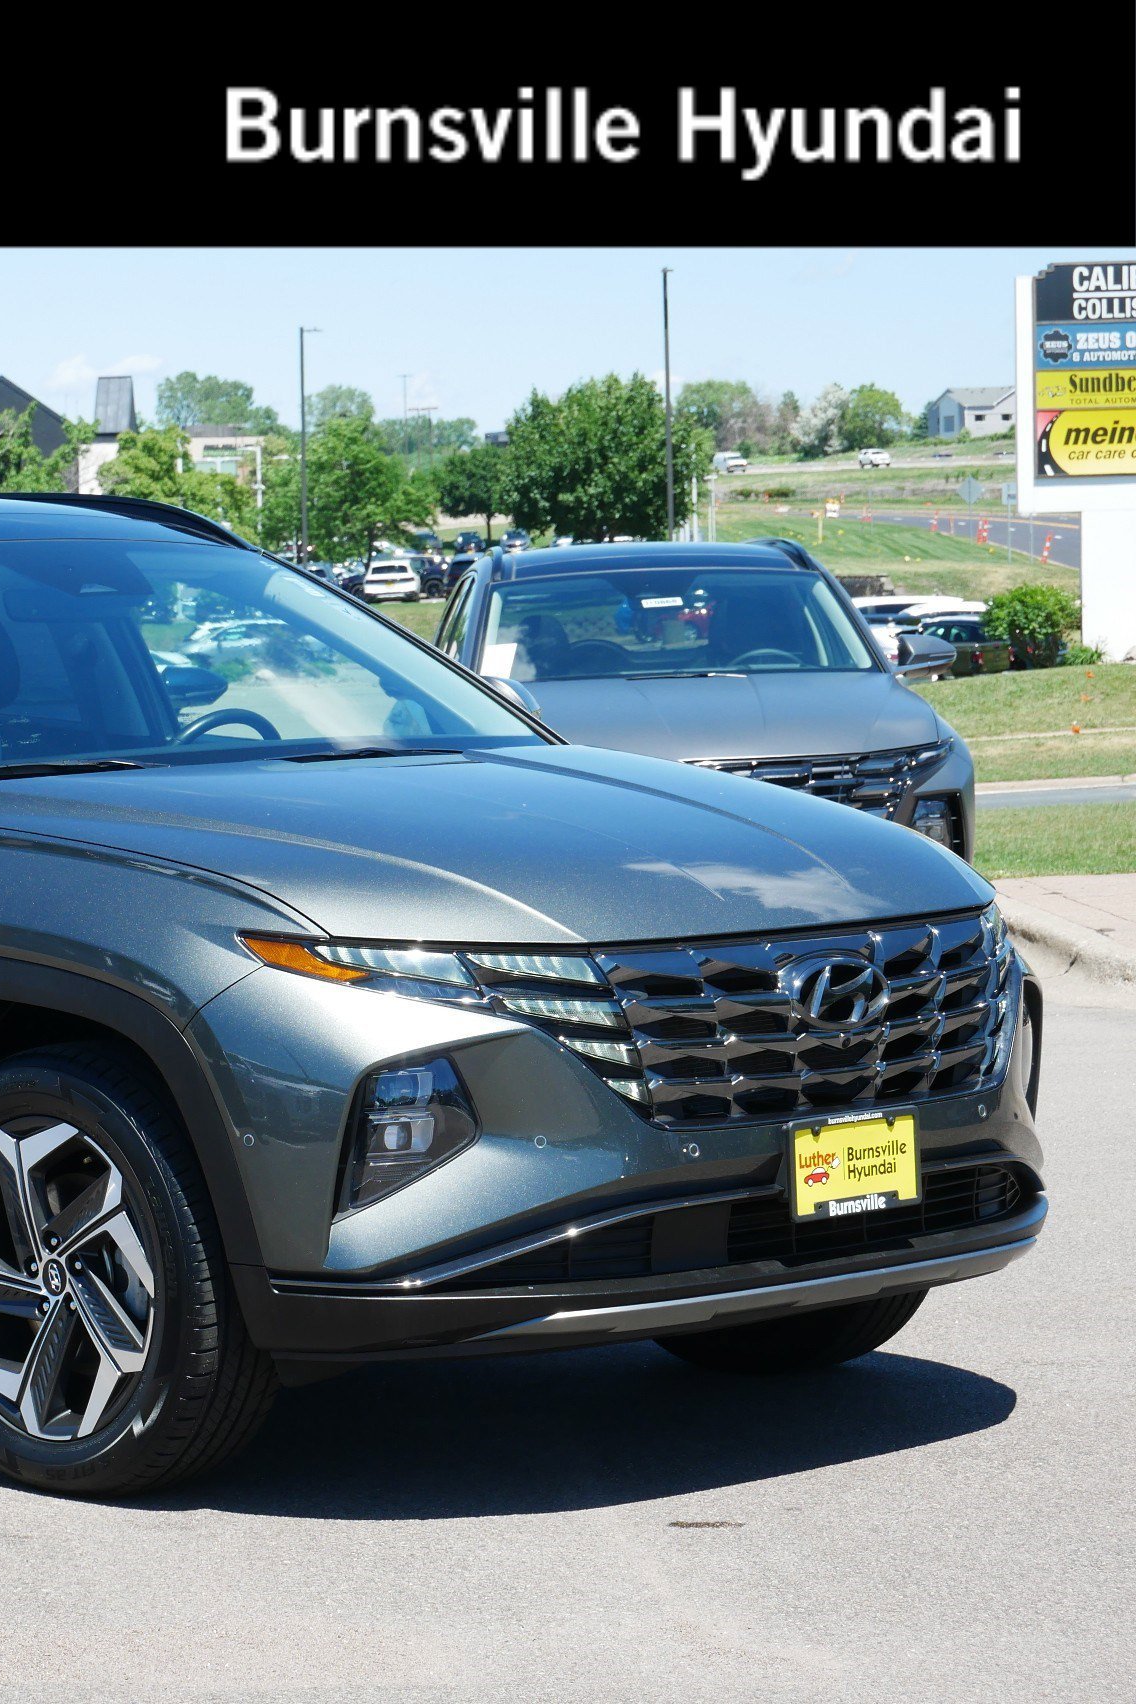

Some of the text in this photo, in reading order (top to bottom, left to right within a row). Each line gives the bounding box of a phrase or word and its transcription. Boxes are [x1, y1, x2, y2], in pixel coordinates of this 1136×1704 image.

[1076, 331, 1121, 349] ZEUS
[1070, 397, 1099, 405] TOTAL
[1068, 450, 1090, 460] car
[1095, 449, 1126, 459] care
[847, 1140, 907, 1161] Burnsville
[798, 1151, 837, 1169] Luther
[848, 1158, 897, 1182] Hyundai
[828, 1193, 886, 1217] Burnsville
